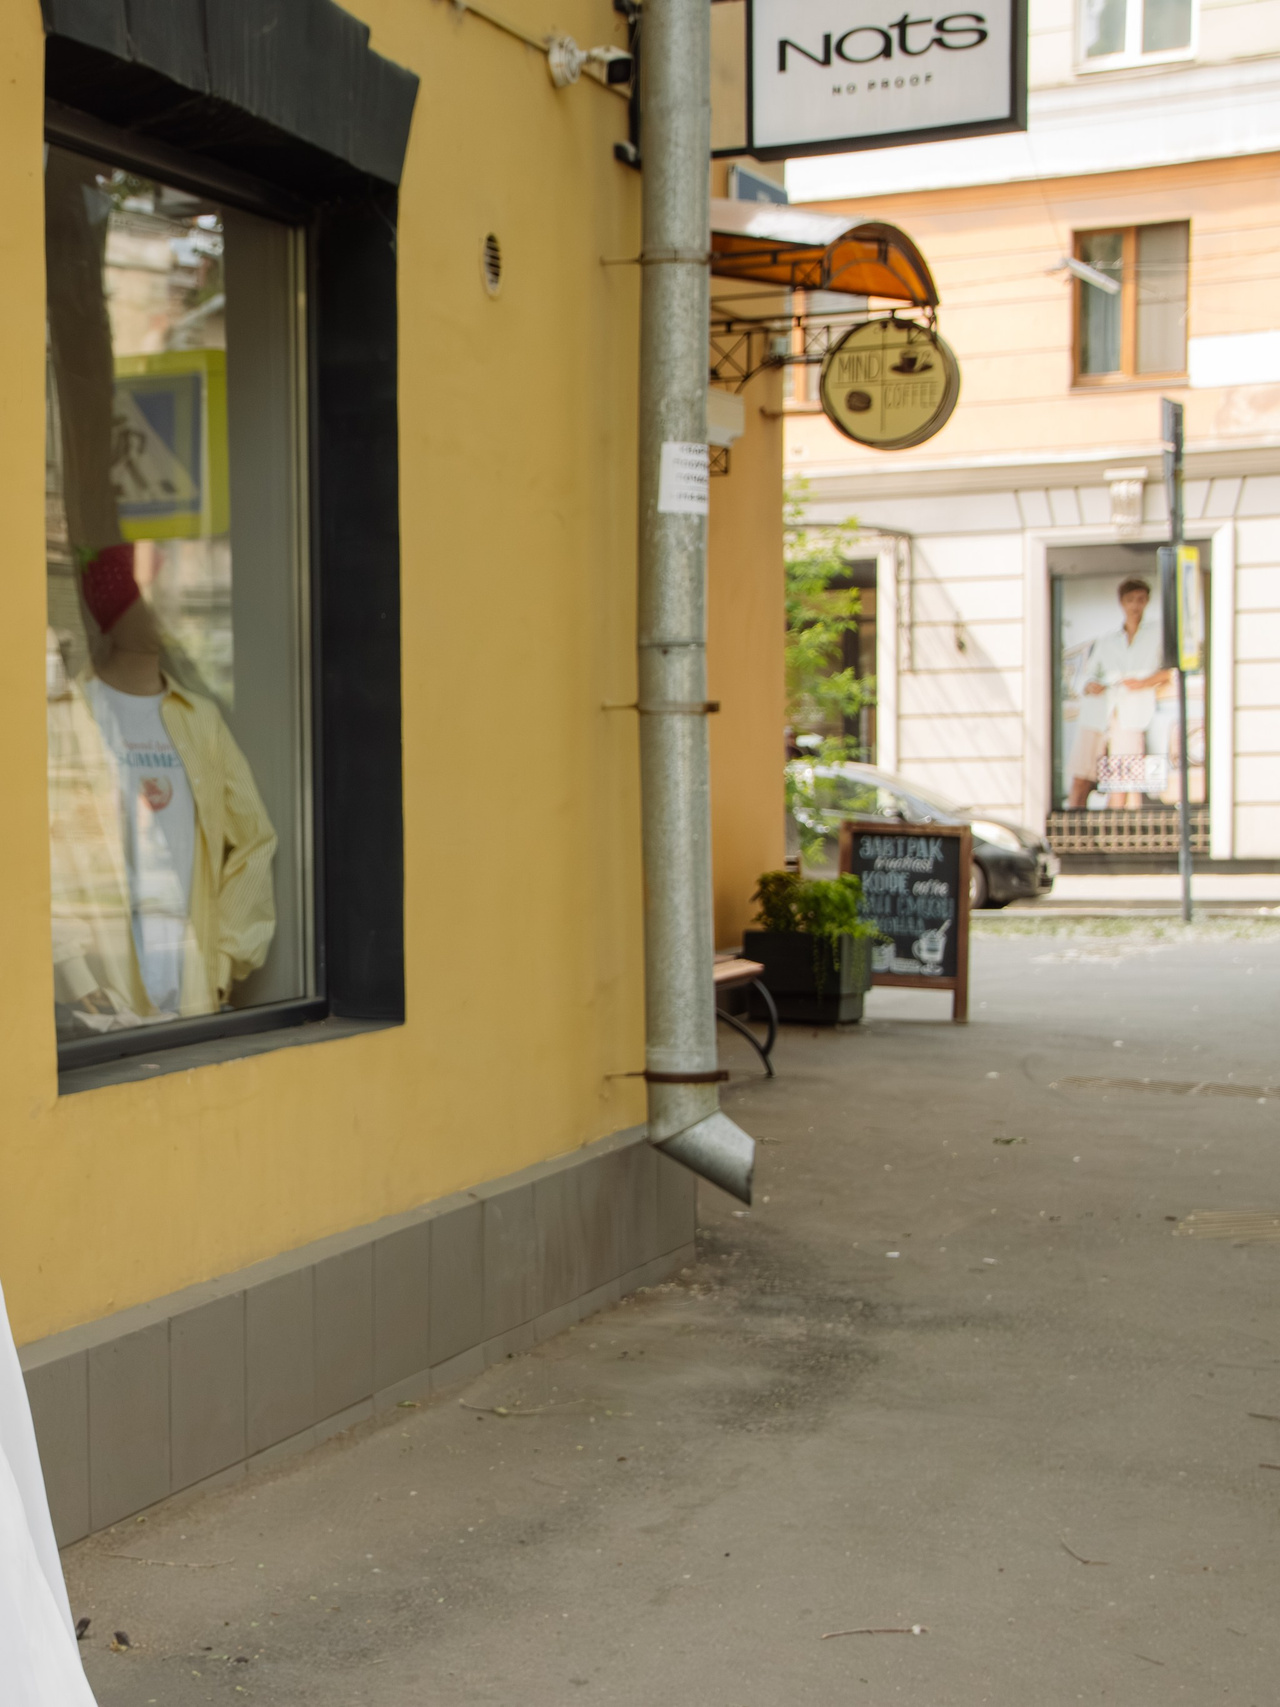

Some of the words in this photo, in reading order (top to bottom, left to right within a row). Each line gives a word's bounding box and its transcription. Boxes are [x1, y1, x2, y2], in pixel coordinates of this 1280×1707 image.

[777, 12, 989, 74] Nats
[831, 84, 857, 96] NO
[867, 73, 934, 91] PROOF
[837, 351, 880, 384] MIND
[884, 383, 937, 409] COFFEE
[859, 835, 944, 861] ЗАВТРАК
